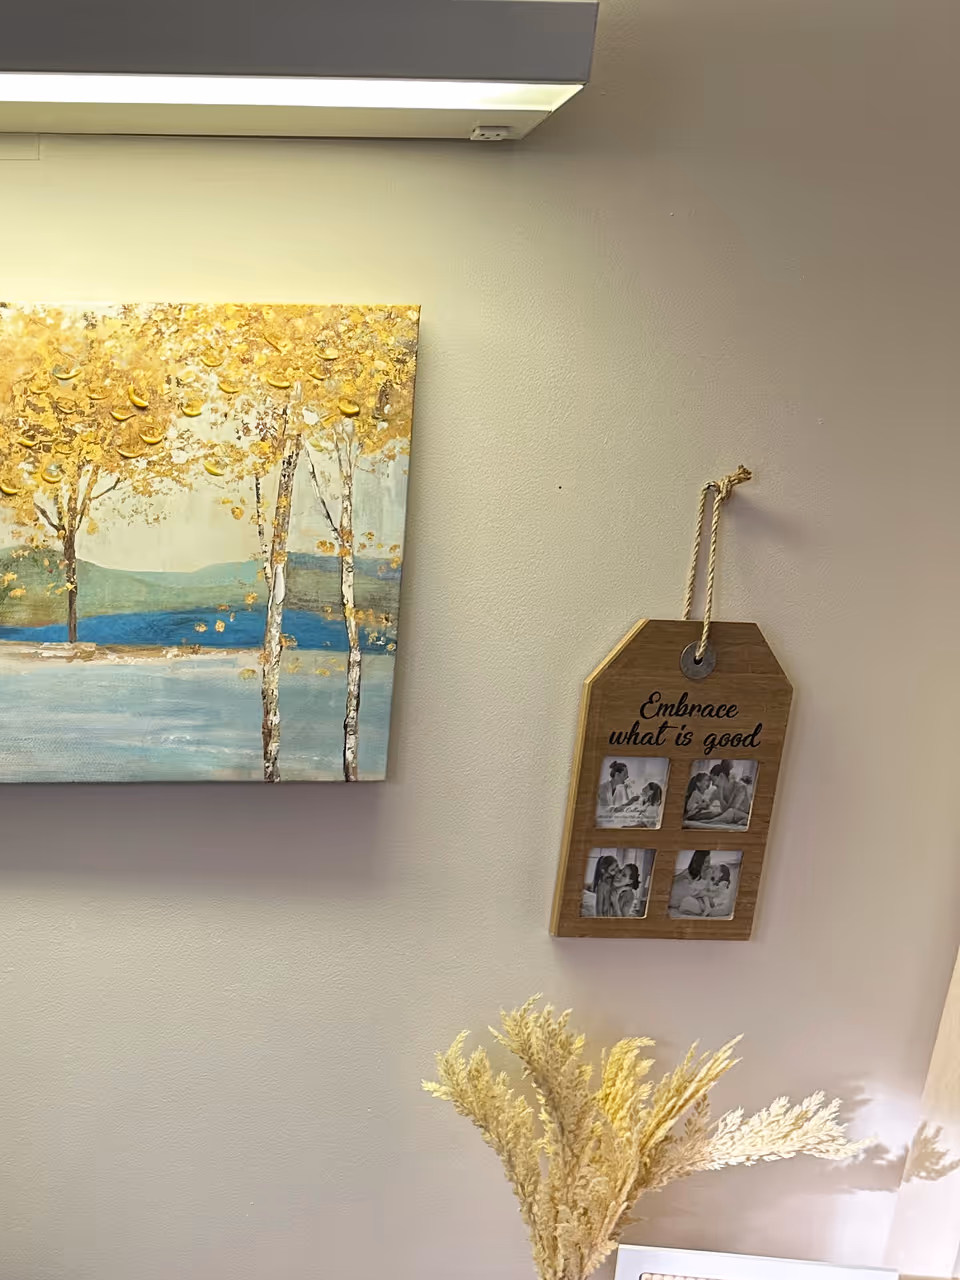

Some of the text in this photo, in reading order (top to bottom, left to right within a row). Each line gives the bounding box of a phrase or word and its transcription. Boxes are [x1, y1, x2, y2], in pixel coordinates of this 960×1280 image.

[640, 691, 739, 719] Embrace
[608, 720, 763, 755] what is good
